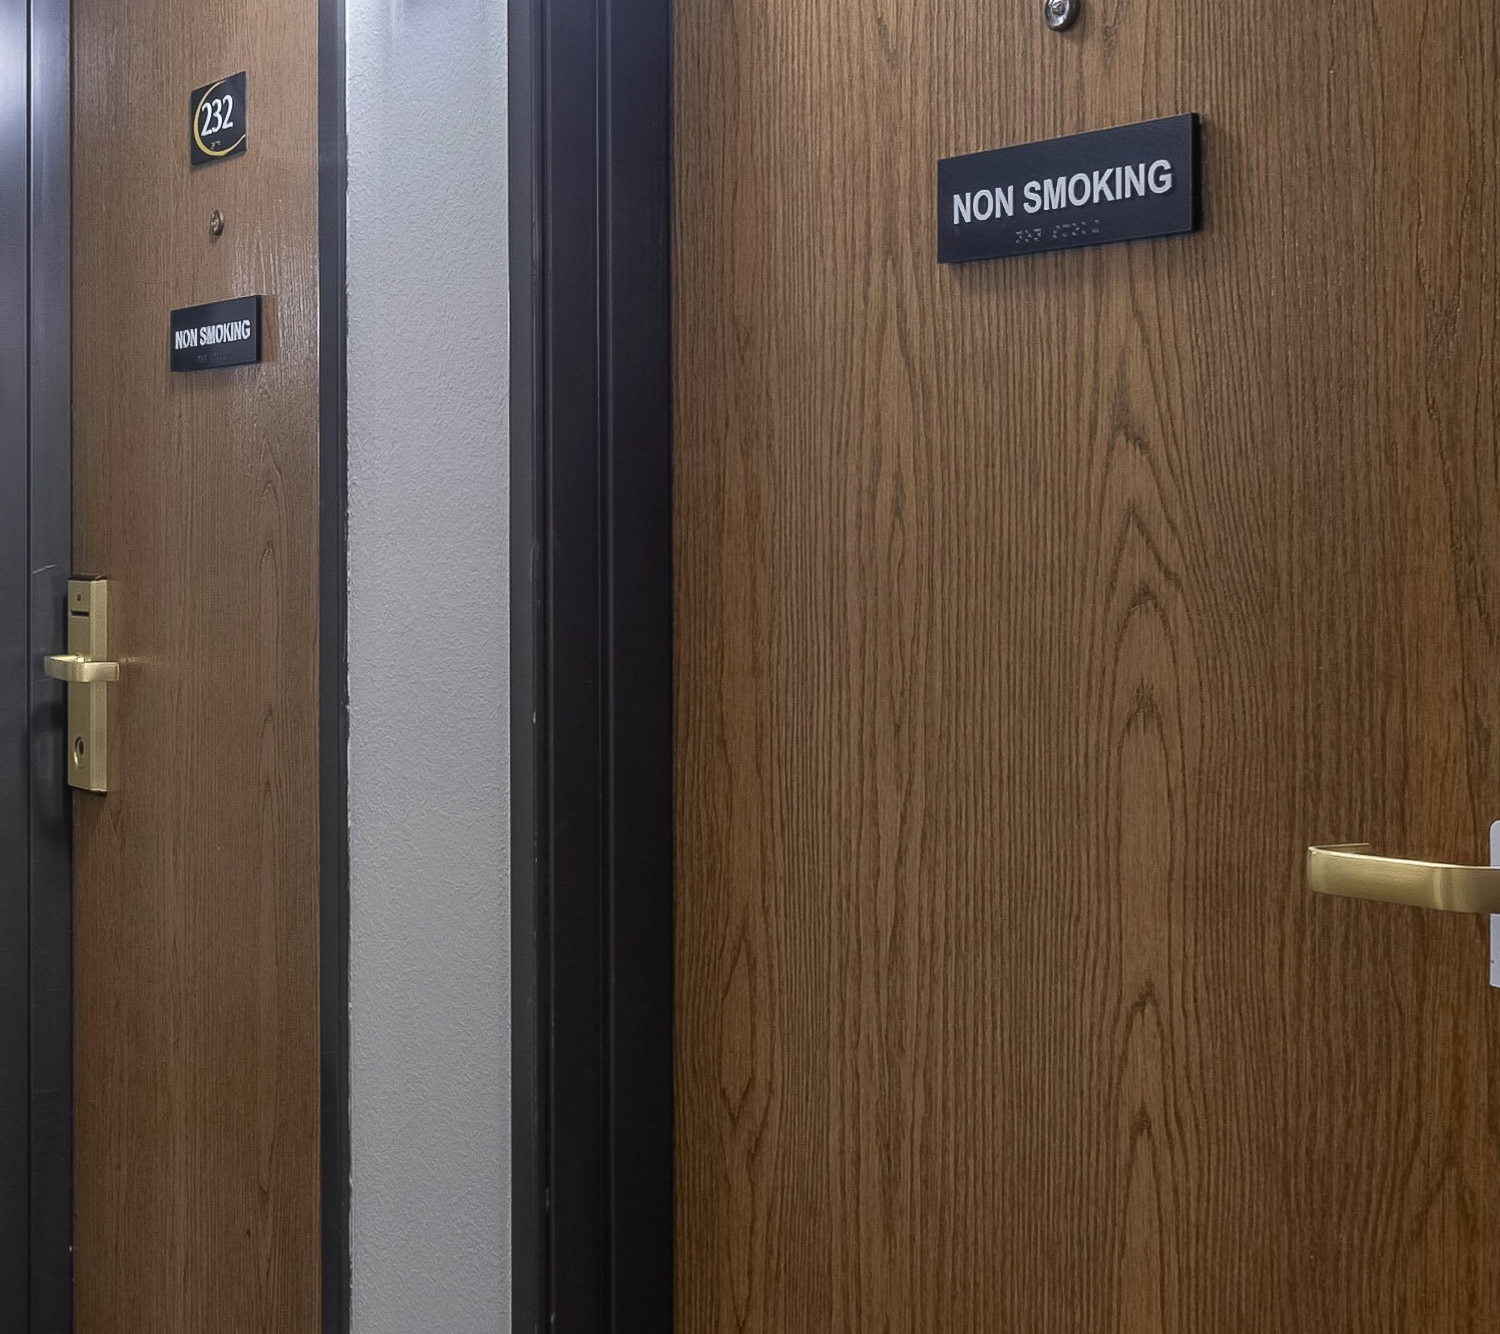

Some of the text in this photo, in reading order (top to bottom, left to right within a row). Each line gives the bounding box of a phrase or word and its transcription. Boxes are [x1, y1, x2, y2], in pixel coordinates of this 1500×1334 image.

[201, 94, 233, 137] 232
[953, 159, 1172, 224] NON SMOKING
[175, 319, 251, 350] NON SMOKING
